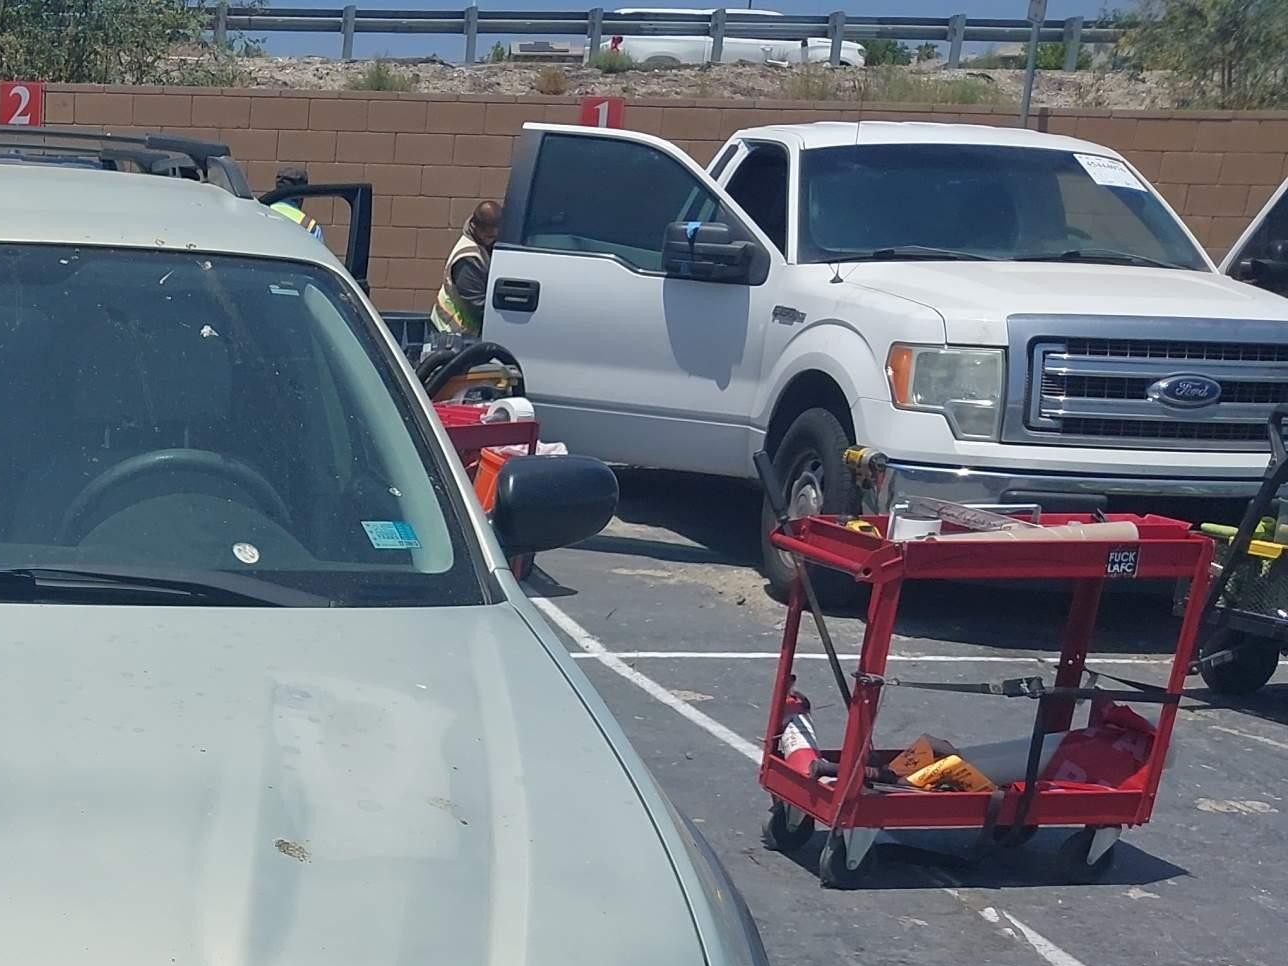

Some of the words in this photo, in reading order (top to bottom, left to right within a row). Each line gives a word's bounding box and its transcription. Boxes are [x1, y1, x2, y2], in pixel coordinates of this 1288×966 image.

[8, 85, 31, 125] 2
[593, 100, 609, 128] 1
[1175, 381, 1209, 397] Ford
[1108, 551, 1137, 562] FUCK
[1107, 562, 1134, 573] LAFC
